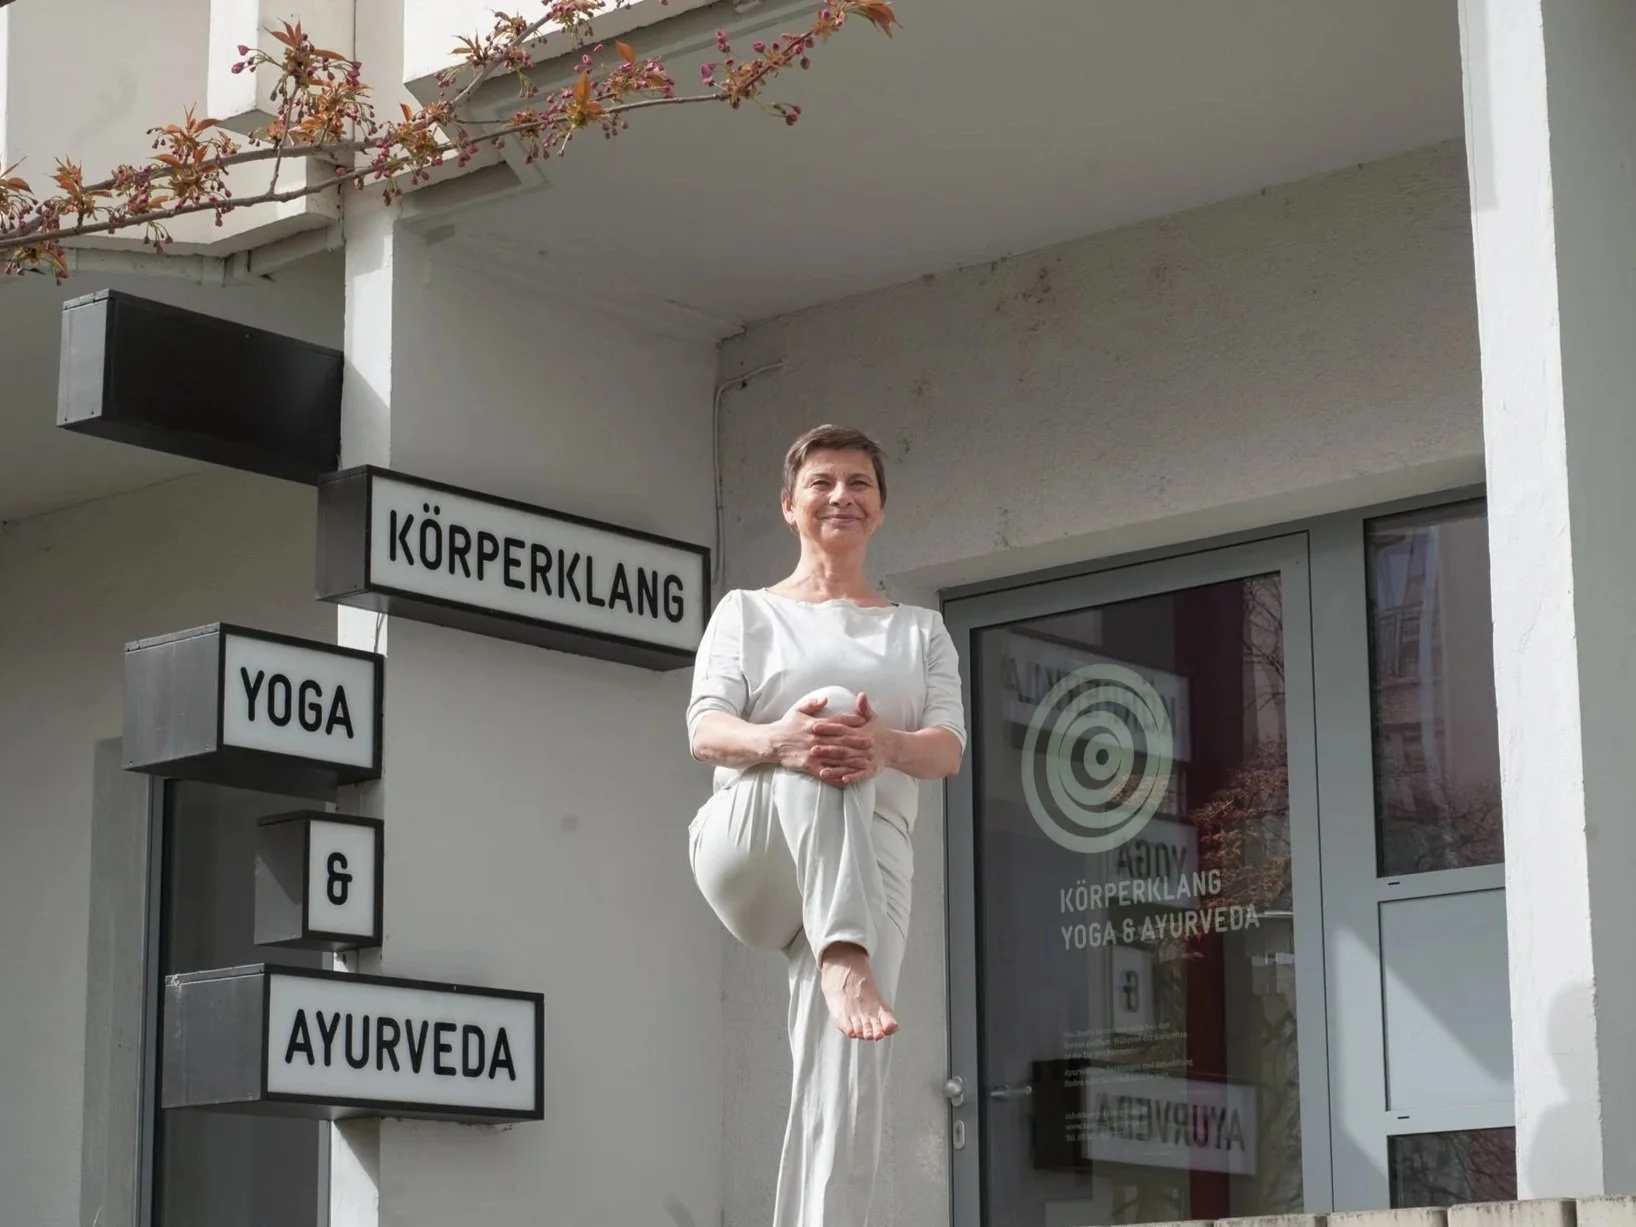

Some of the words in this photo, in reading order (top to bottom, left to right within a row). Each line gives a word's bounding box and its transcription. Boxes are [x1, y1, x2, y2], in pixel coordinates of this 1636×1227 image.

[389, 503, 684, 623] KÖRPERKLANG
[240, 666, 354, 739] YOGA
[327, 852, 353, 906] &
[1060, 868, 1222, 914] KÖRPERKLANG
[1061, 921, 1116, 950] YOGA
[1122, 918, 1136, 943] &
[1141, 903, 1260, 942] AYURVEDA
[285, 1008, 516, 1081] AYURVEDA
